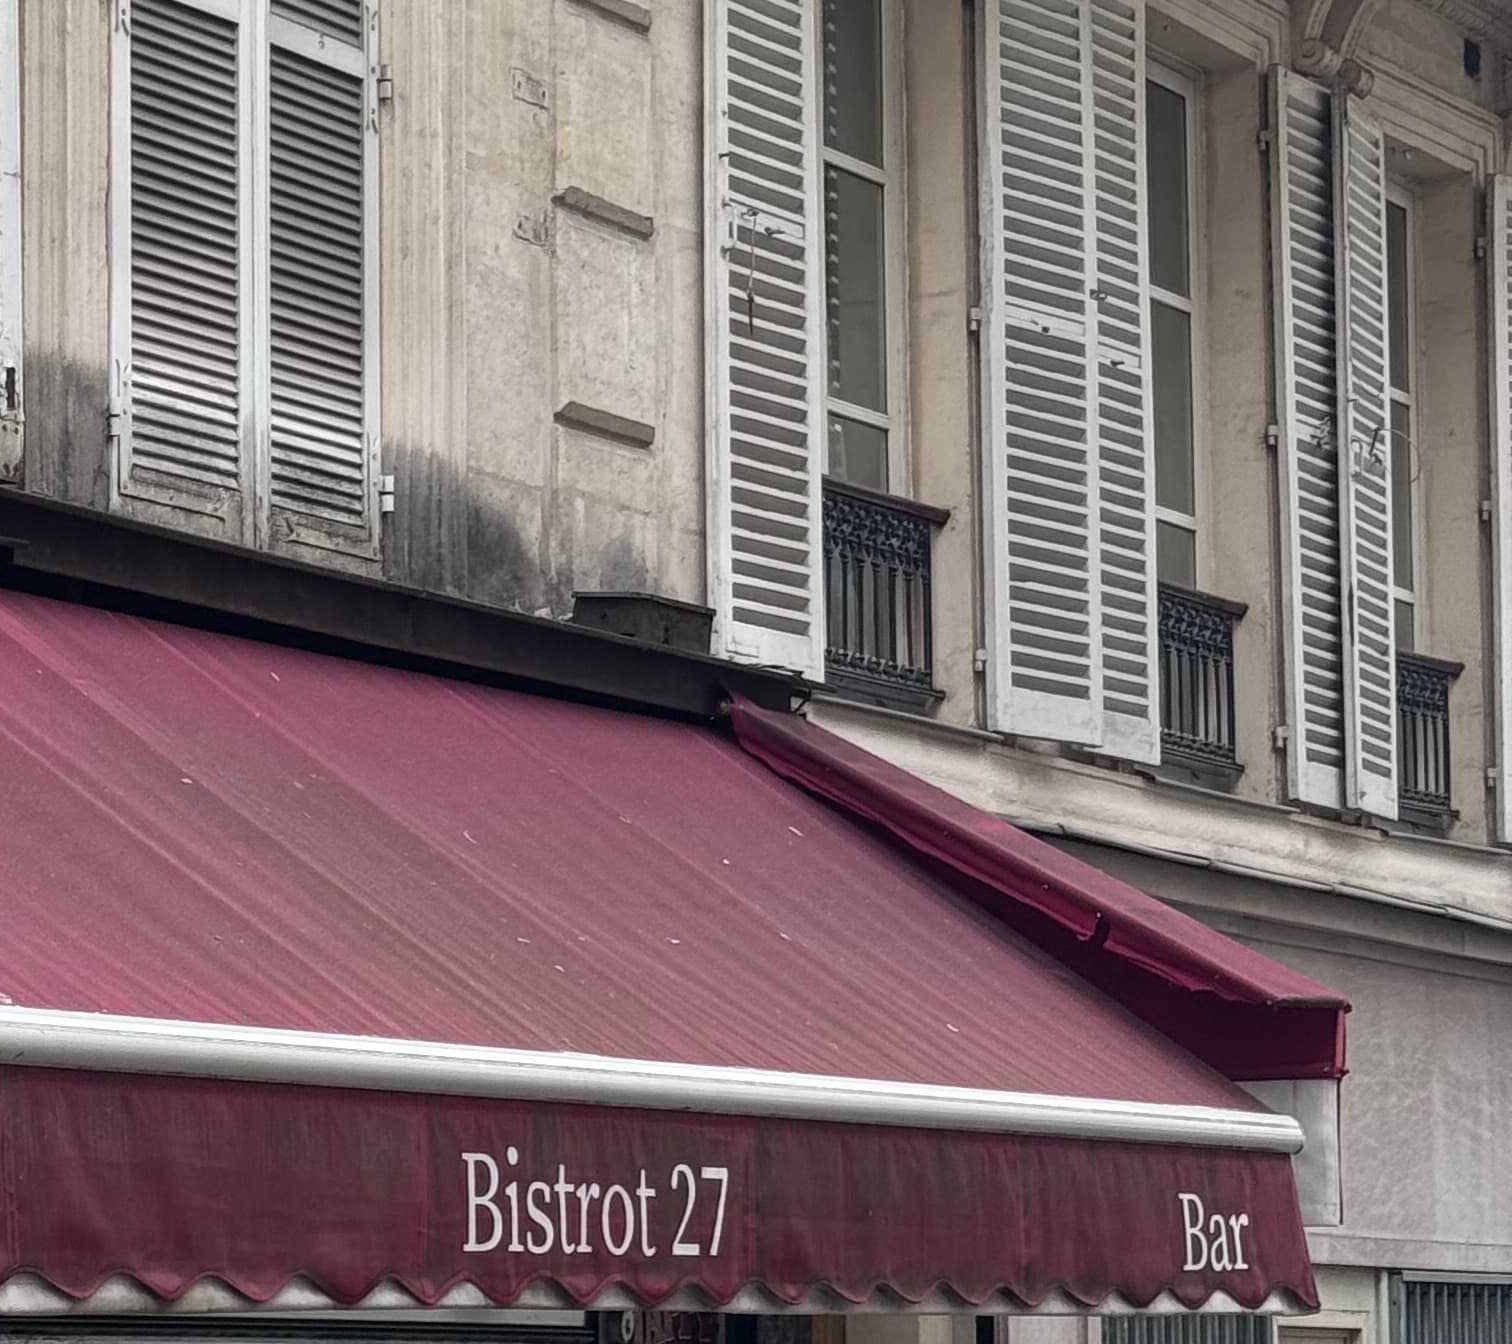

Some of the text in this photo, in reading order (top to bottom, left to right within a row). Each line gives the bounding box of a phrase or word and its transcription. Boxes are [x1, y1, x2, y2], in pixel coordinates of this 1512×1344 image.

[461, 1146, 729, 1256] Bistrot 27
[1178, 1192, 1249, 1272] Bar
